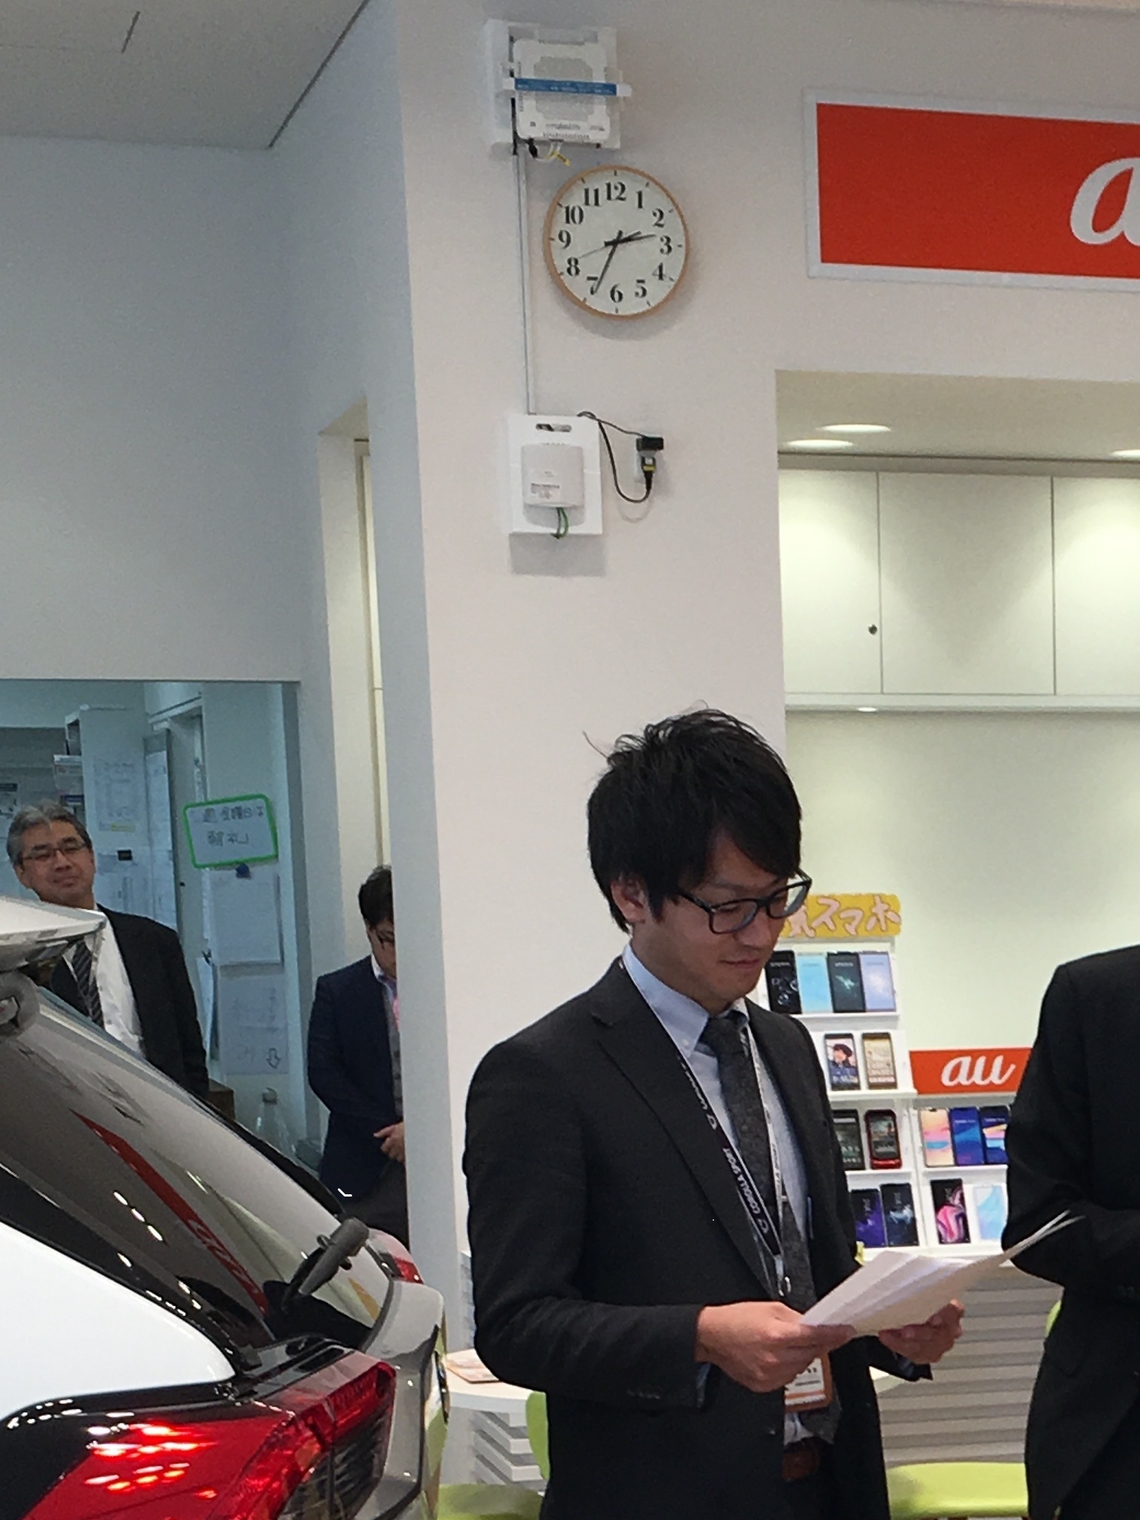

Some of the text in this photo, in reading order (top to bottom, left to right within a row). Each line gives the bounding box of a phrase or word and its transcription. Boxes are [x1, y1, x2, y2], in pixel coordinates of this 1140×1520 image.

[583, 187, 600, 207] 11
[605, 181, 627, 201] 12
[636, 190, 643, 209] 1
[564, 205, 584, 225] 10
[652, 208, 665, 228] 2
[558, 230, 572, 249] 9
[659, 235, 673, 255] 3
[566, 257, 580, 277] 8
[652, 263, 665, 281] 4
[586, 276, 599, 295] 7
[610, 283, 623, 303] 6
[635, 279, 648, 298] 5
[941, 1055, 1016, 1087] au
